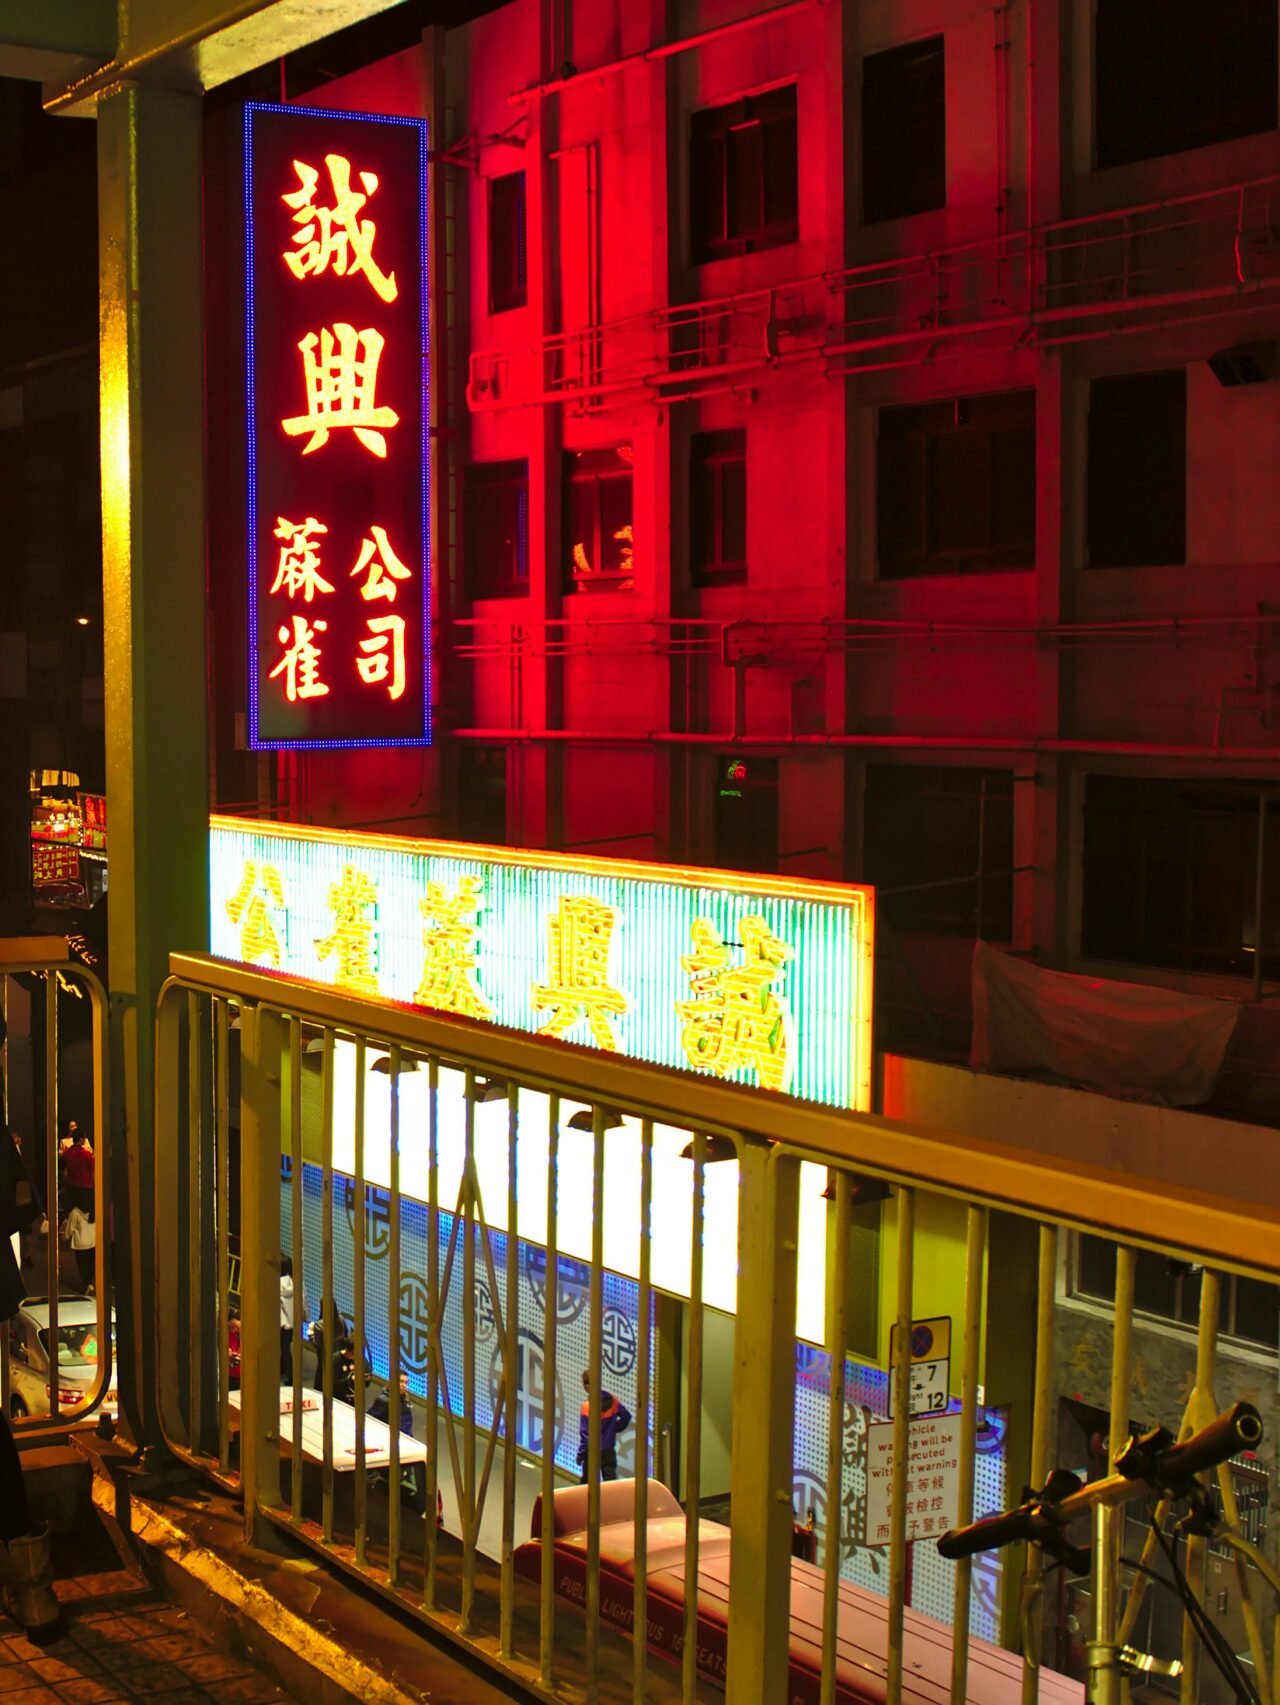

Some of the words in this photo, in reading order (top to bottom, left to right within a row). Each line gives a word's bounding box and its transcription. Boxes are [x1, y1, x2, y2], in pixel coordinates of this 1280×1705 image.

[280, 153, 400, 460] 誠興
[349, 524, 414, 702] 公司
[927, 1364, 937, 1382] 7
[285, 1399, 311, 1410] TXI
[927, 1391, 944, 1410] 12
[921, 1435, 939, 1447] will
[941, 1433, 953, 1444] be
[886, 1447, 945, 1465] pecuted
[917, 1458, 958, 1473] warning
[876, 1515, 950, 1538] 而予警告
[559, 1575, 587, 1601] PUBL
